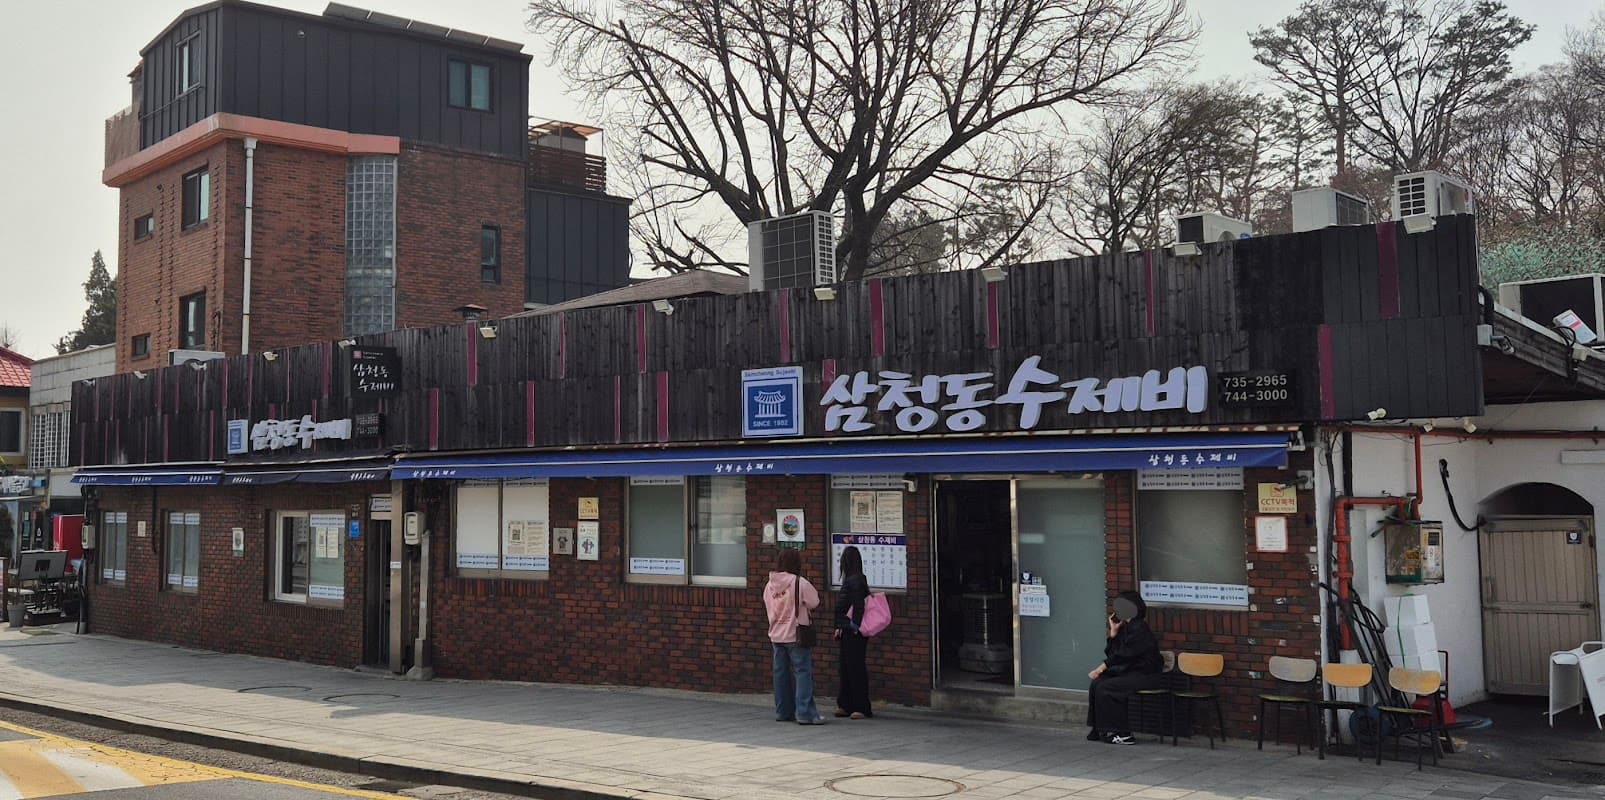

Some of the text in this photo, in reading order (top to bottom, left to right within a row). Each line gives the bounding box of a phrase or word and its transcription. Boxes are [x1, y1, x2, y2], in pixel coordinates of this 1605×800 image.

[353, 364, 389, 378] 삼청동
[358, 379, 394, 392] 수제비
[1224, 374, 1287, 388] 735-2965
[820, 355, 1208, 431] 삼청동수제비
[1224, 389, 1288, 402] 744-3000
[1149, 453, 1237, 466] 삼청동수제비
